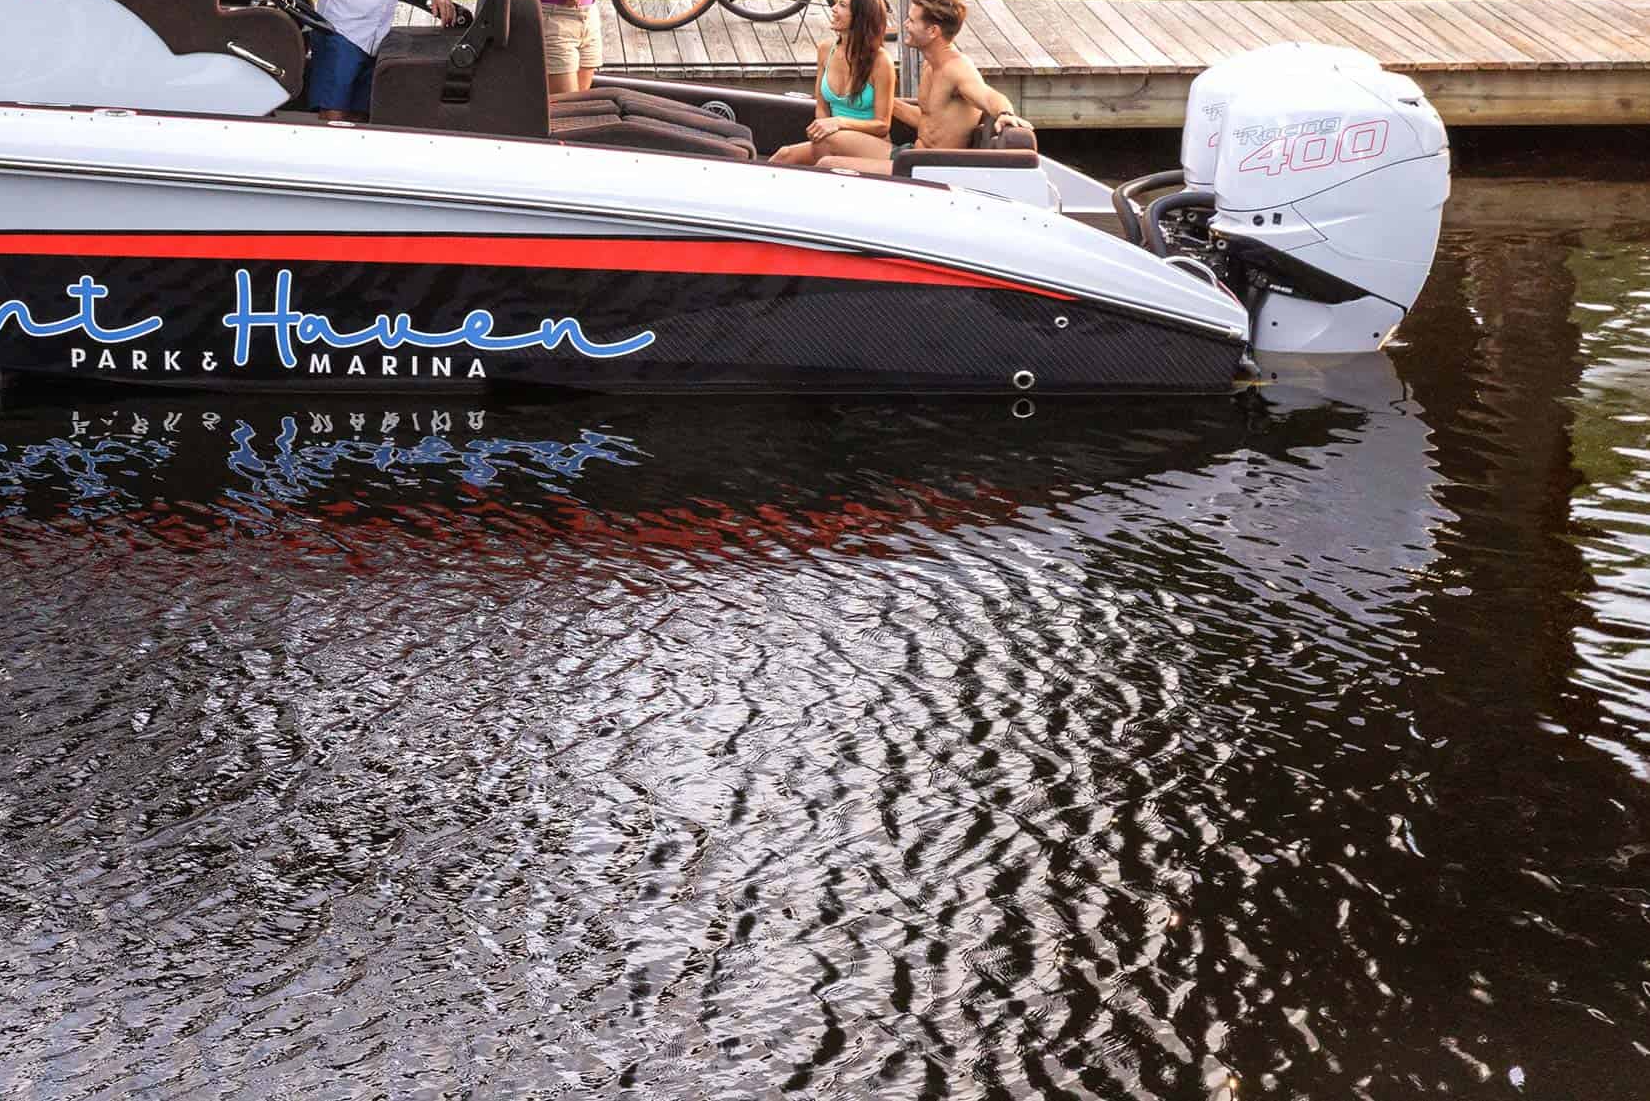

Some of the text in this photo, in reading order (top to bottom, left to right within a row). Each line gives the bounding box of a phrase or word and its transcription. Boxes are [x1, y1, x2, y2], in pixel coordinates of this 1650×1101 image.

[1238, 119, 1391, 177] 400
[222, 269, 656, 368] Haven
[70, 348, 487, 379] PARK & MARINA
